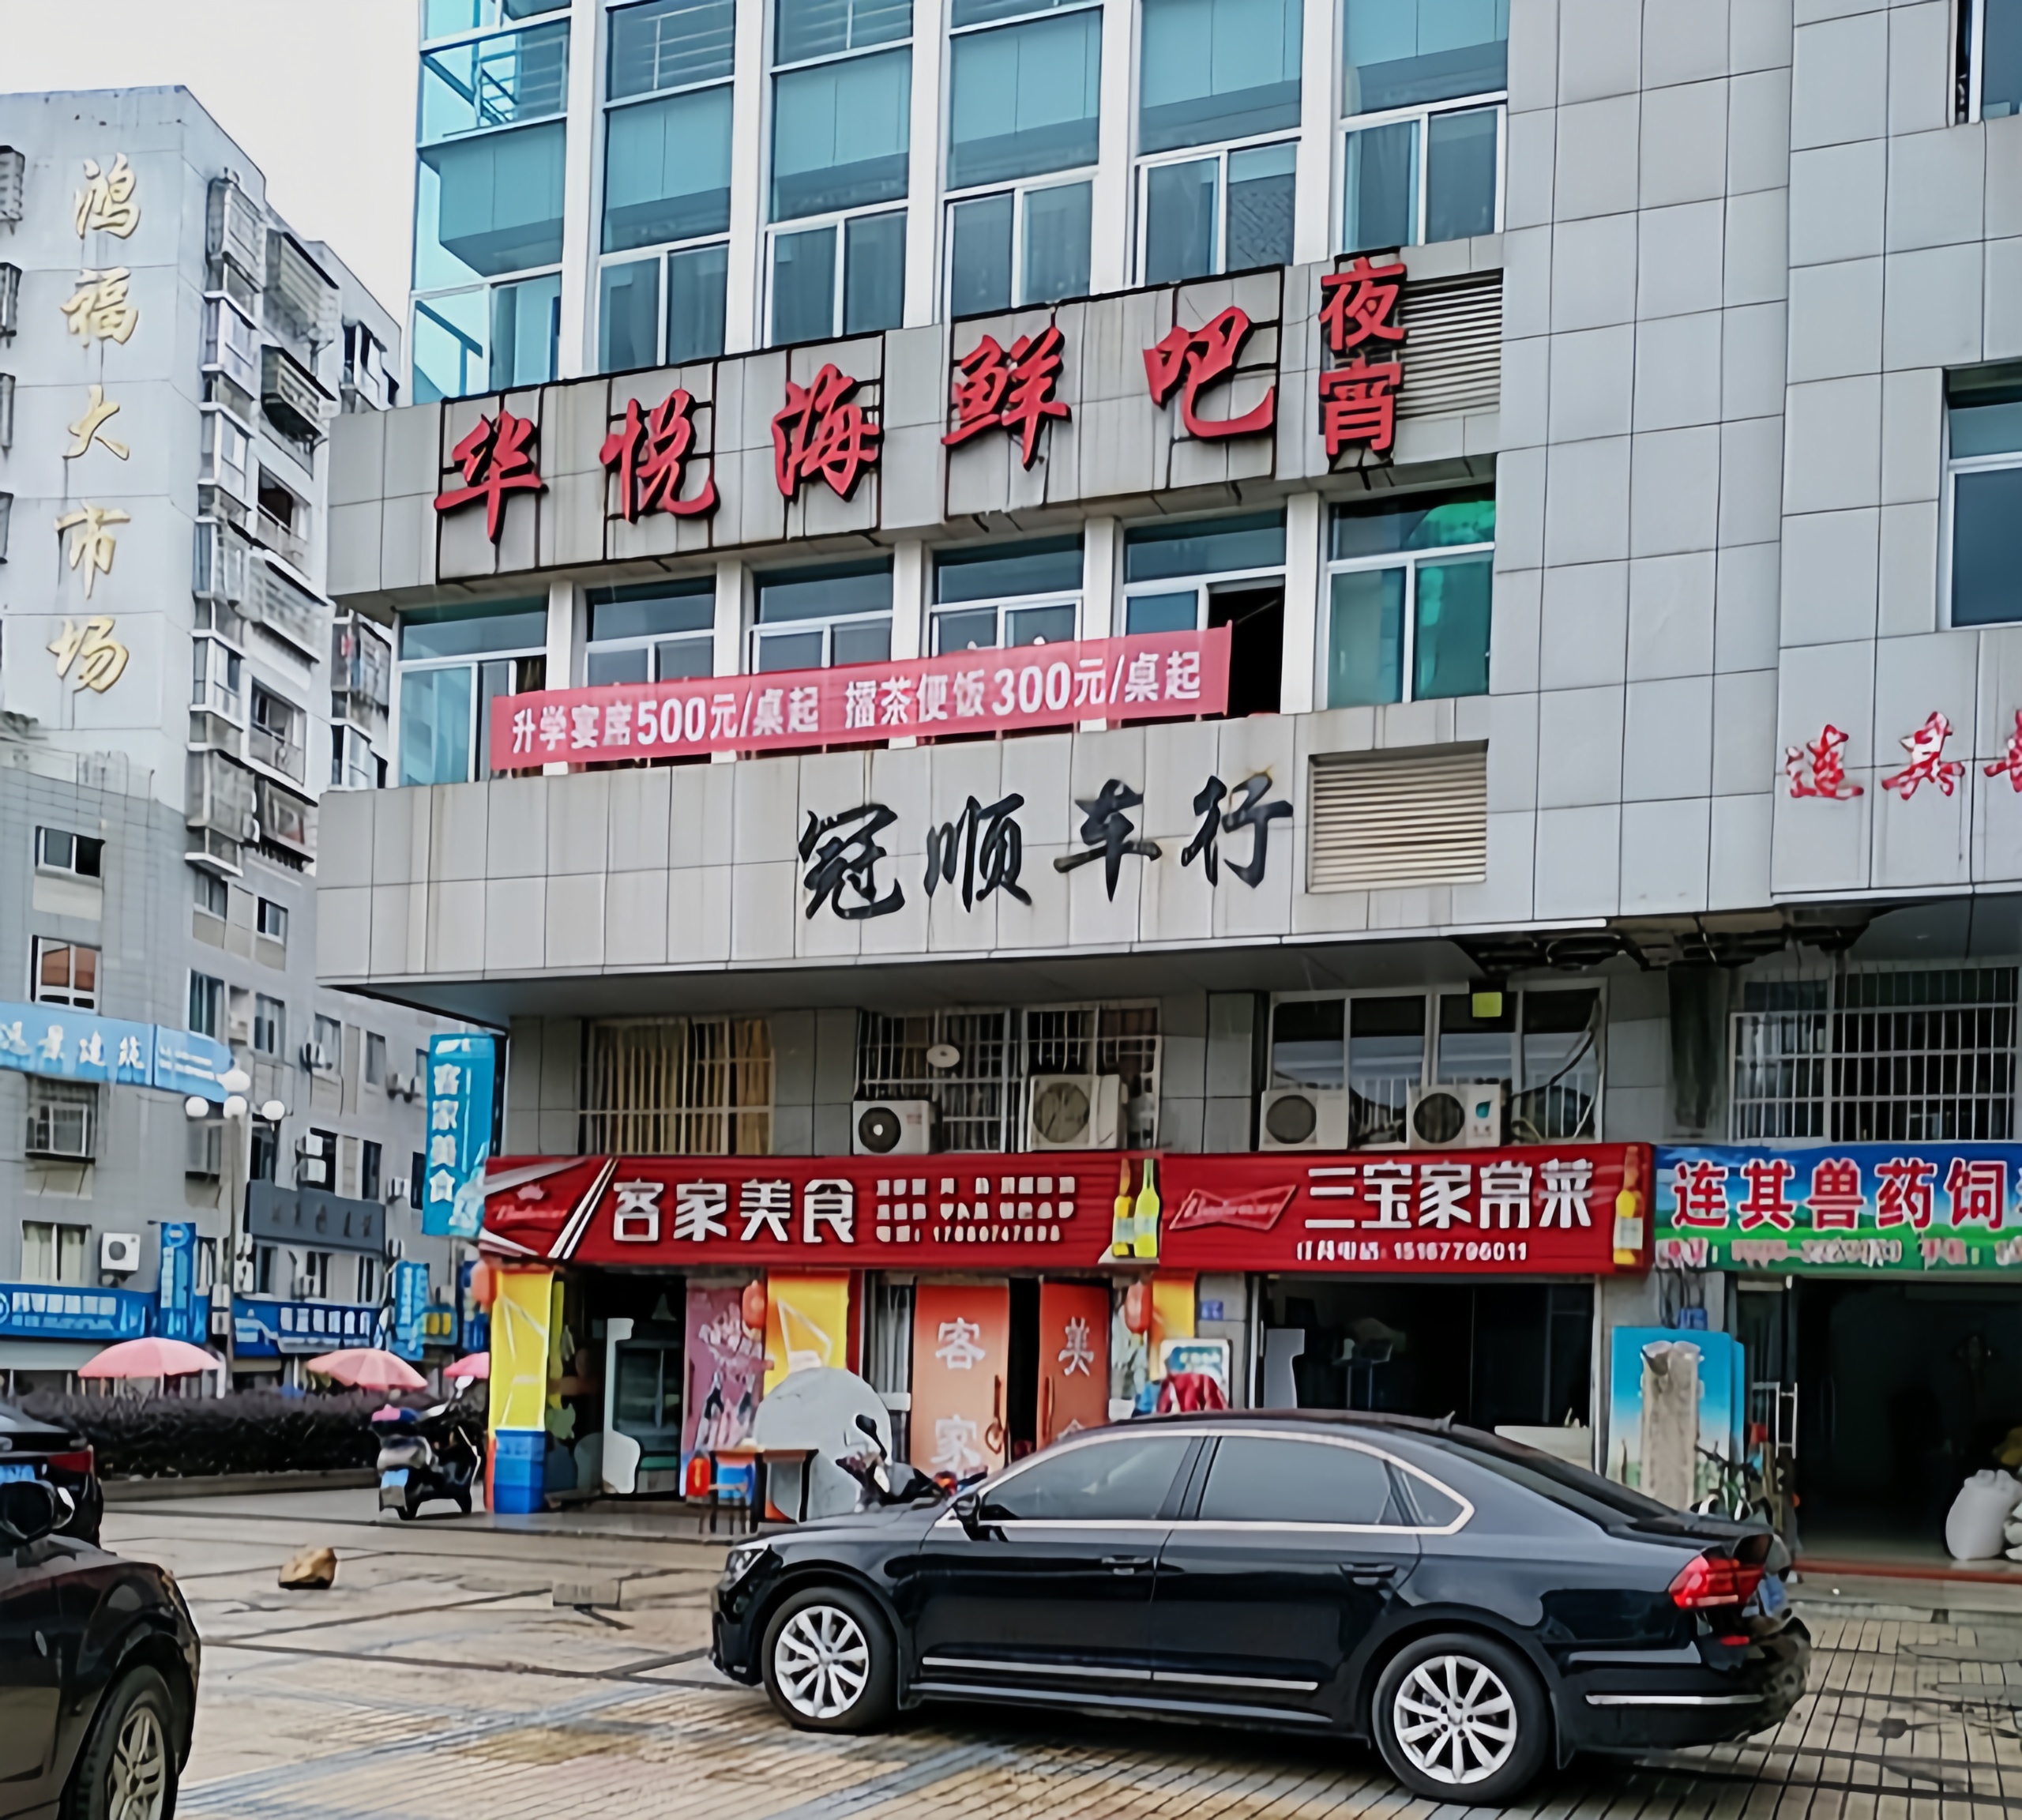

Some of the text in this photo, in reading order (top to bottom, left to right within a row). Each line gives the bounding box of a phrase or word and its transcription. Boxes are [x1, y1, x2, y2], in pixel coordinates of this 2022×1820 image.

[46, 152, 141, 694] 鸿福大市场
[434, 306, 1276, 543] 华悦海鲜吧
[1319, 257, 1407, 456] 夜宵
[799, 772, 1295, 920] 冠顺车行
[613, 1178, 855, 1243] 客家美食
[1305, 1159, 1593, 1229] 三宝家常菜
[1671, 1157, 2022, 1232] 连其兽药饲
[930, 1317, 986, 1469] 客家
